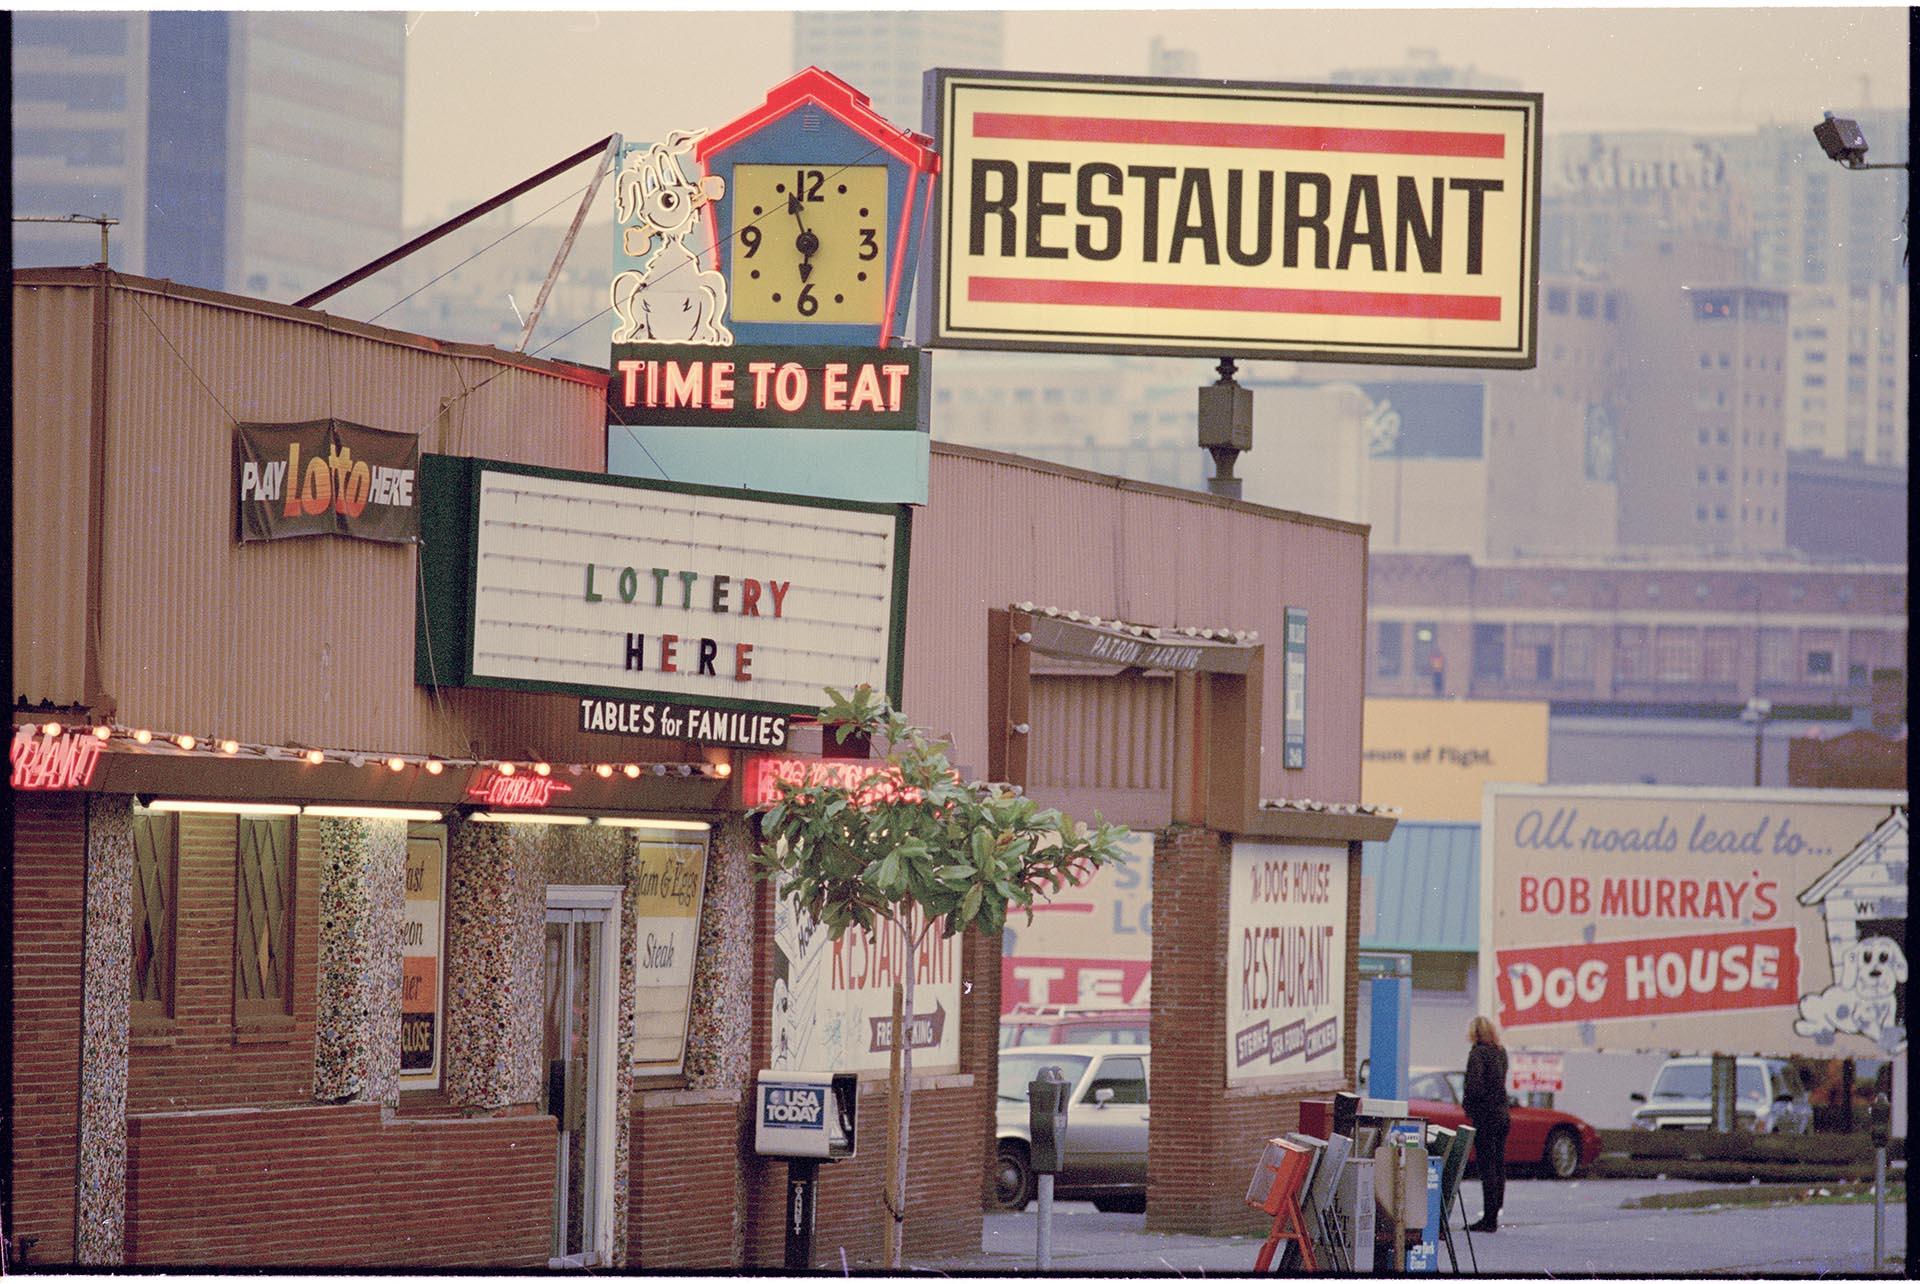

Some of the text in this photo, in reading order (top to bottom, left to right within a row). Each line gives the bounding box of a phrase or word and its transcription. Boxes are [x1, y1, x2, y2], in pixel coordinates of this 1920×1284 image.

[797, 170, 825, 202] 12
[968, 158, 1505, 276] RESTAURANT
[740, 225, 879, 261] 9 3
[797, 283, 819, 317] 6
[617, 360, 910, 412] TIME TO EAT
[241, 460, 287, 501] PLAY
[368, 465, 415, 506] HERE
[584, 562, 790, 618] LOTTERY
[625, 632, 753, 682] HERE
[1090, 635, 1203, 669] PATRON PARKING
[581, 700, 786, 746] TABLES for FAMILIES
[1514, 807, 1574, 849] All
[1580, 815, 1678, 853] roads
[1688, 814, 1770, 853] lead
[671, 861, 699, 907] Eggs
[1264, 861, 1289, 903] DOG
[1292, 861, 1331, 904] HOUSE
[1520, 869, 1778, 921] BOB MURRAY'S
[642, 931, 675, 969] Steak
[1242, 926, 1334, 1010] RESTAURANT
[1507, 944, 1780, 1012] DOG HOUSE
[876, 1021, 898, 1046] FRE
[766, 1104, 822, 1124] TODAY
[784, 1090, 819, 1107] USA
